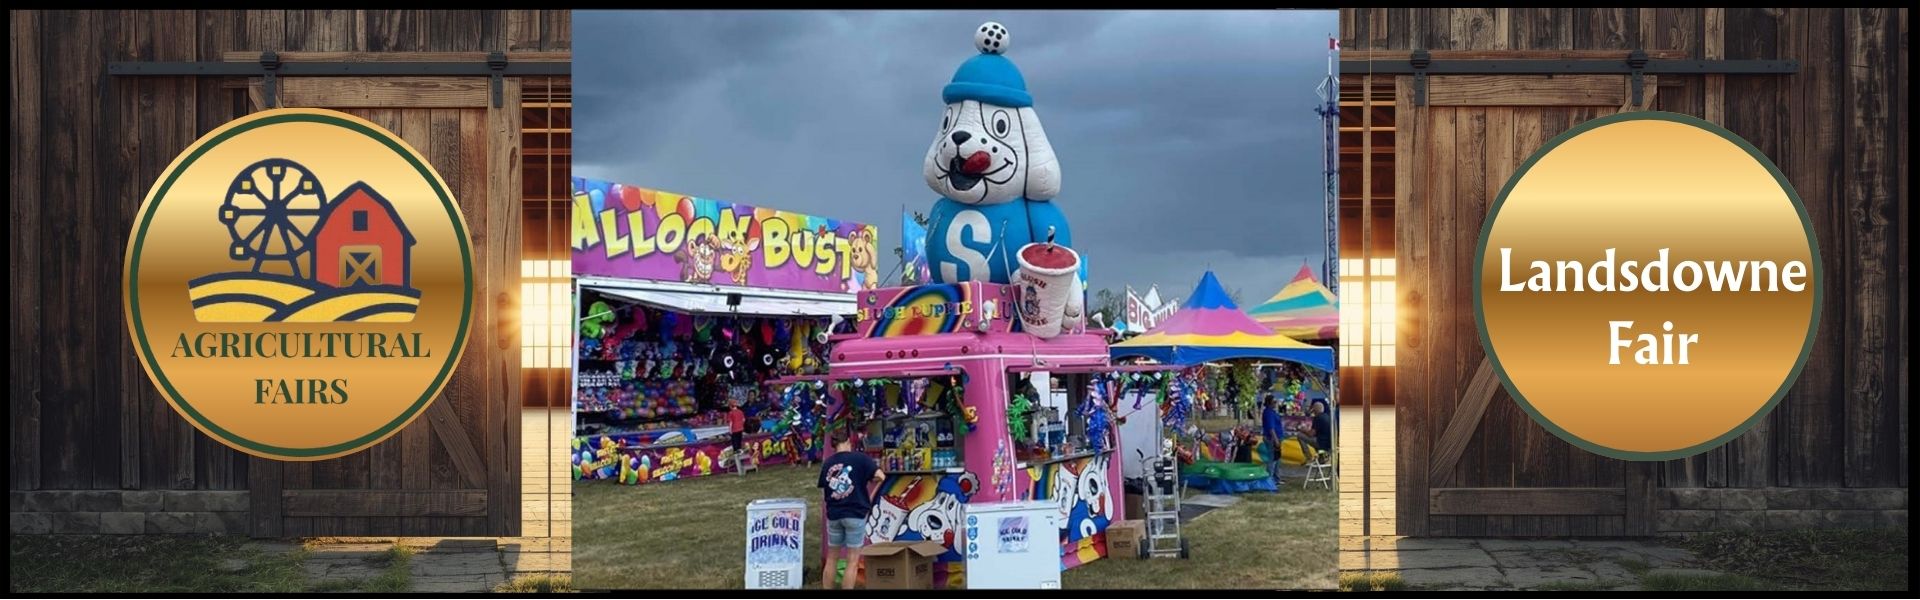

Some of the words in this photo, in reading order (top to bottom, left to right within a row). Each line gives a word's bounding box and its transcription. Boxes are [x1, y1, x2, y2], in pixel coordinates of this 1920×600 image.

[572, 193, 751, 260] ALLOON
[761, 216, 851, 279] BUST
[940, 210, 992, 283] S
[1128, 296, 1151, 330] BIG
[772, 516, 799, 531] COLD
[751, 534, 799, 553] DRINKS
